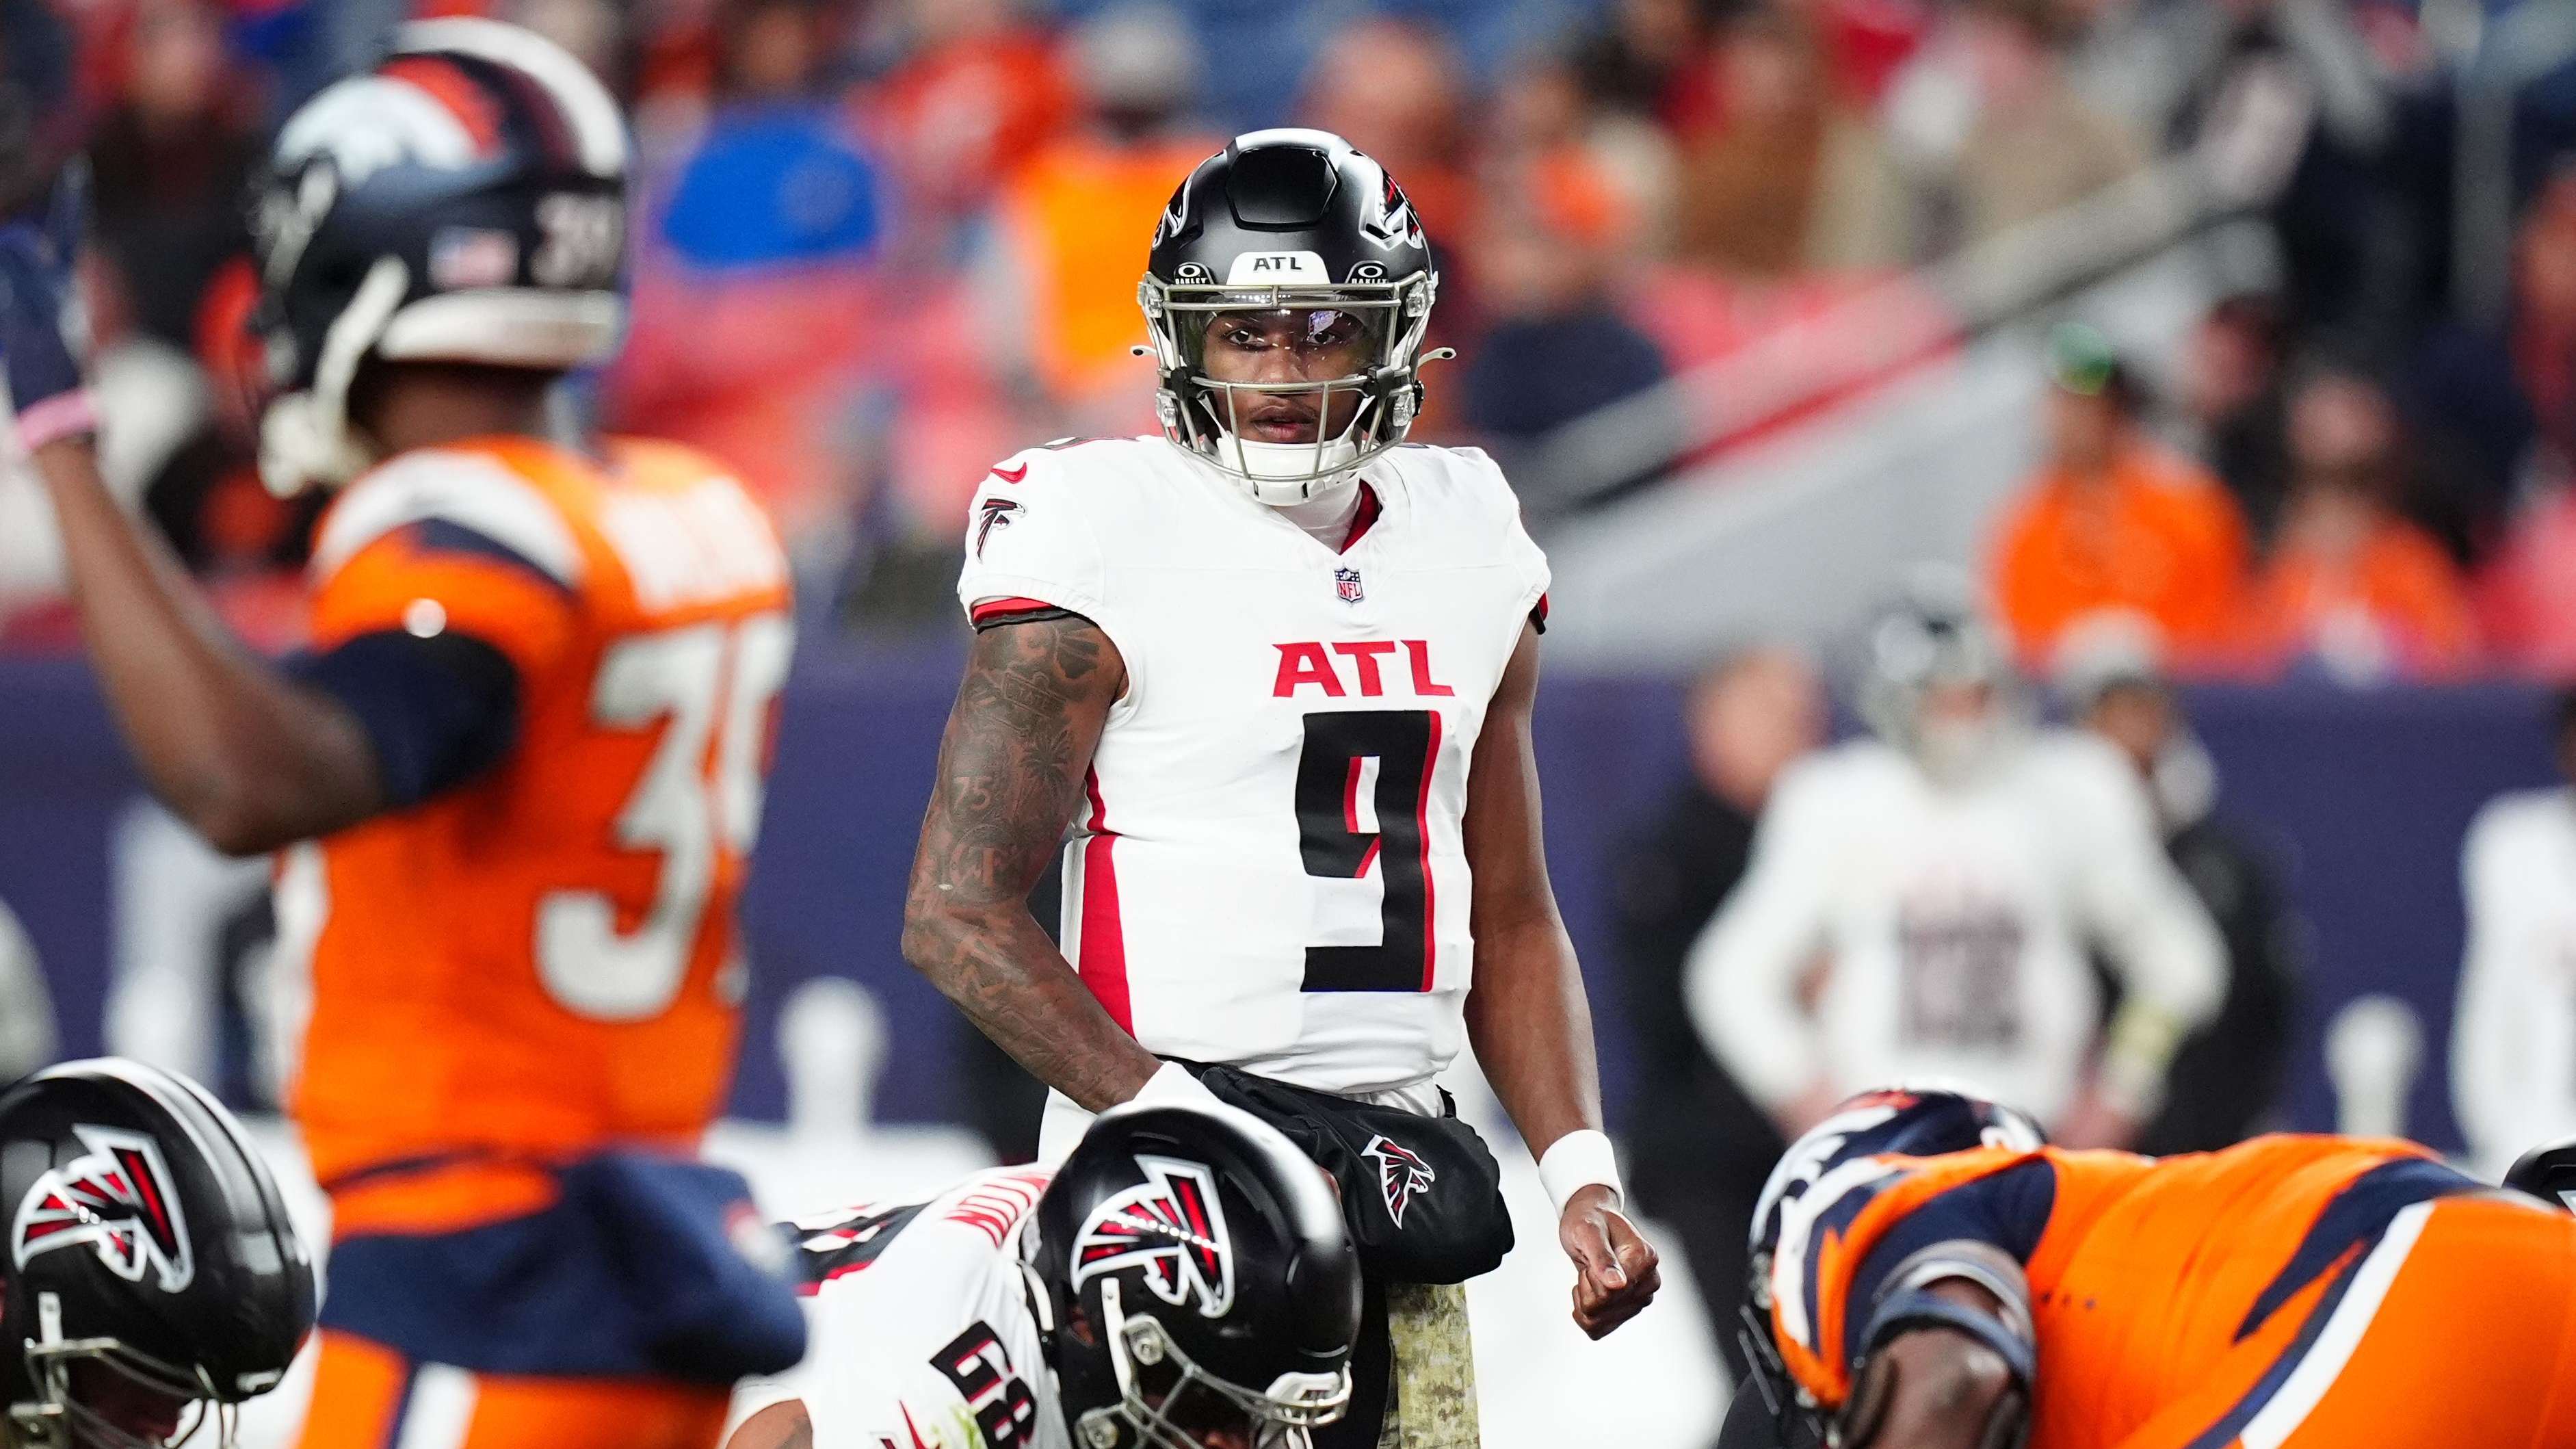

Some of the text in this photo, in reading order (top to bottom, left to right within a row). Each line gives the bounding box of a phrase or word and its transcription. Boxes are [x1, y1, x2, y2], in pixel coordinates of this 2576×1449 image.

[1253, 257, 1302, 271] ATL
[1338, 581, 1361, 599] NFL
[1272, 640, 1455, 697] ATL
[1295, 709, 1441, 993] 9
[929, 1320, 1037, 1449] 68
